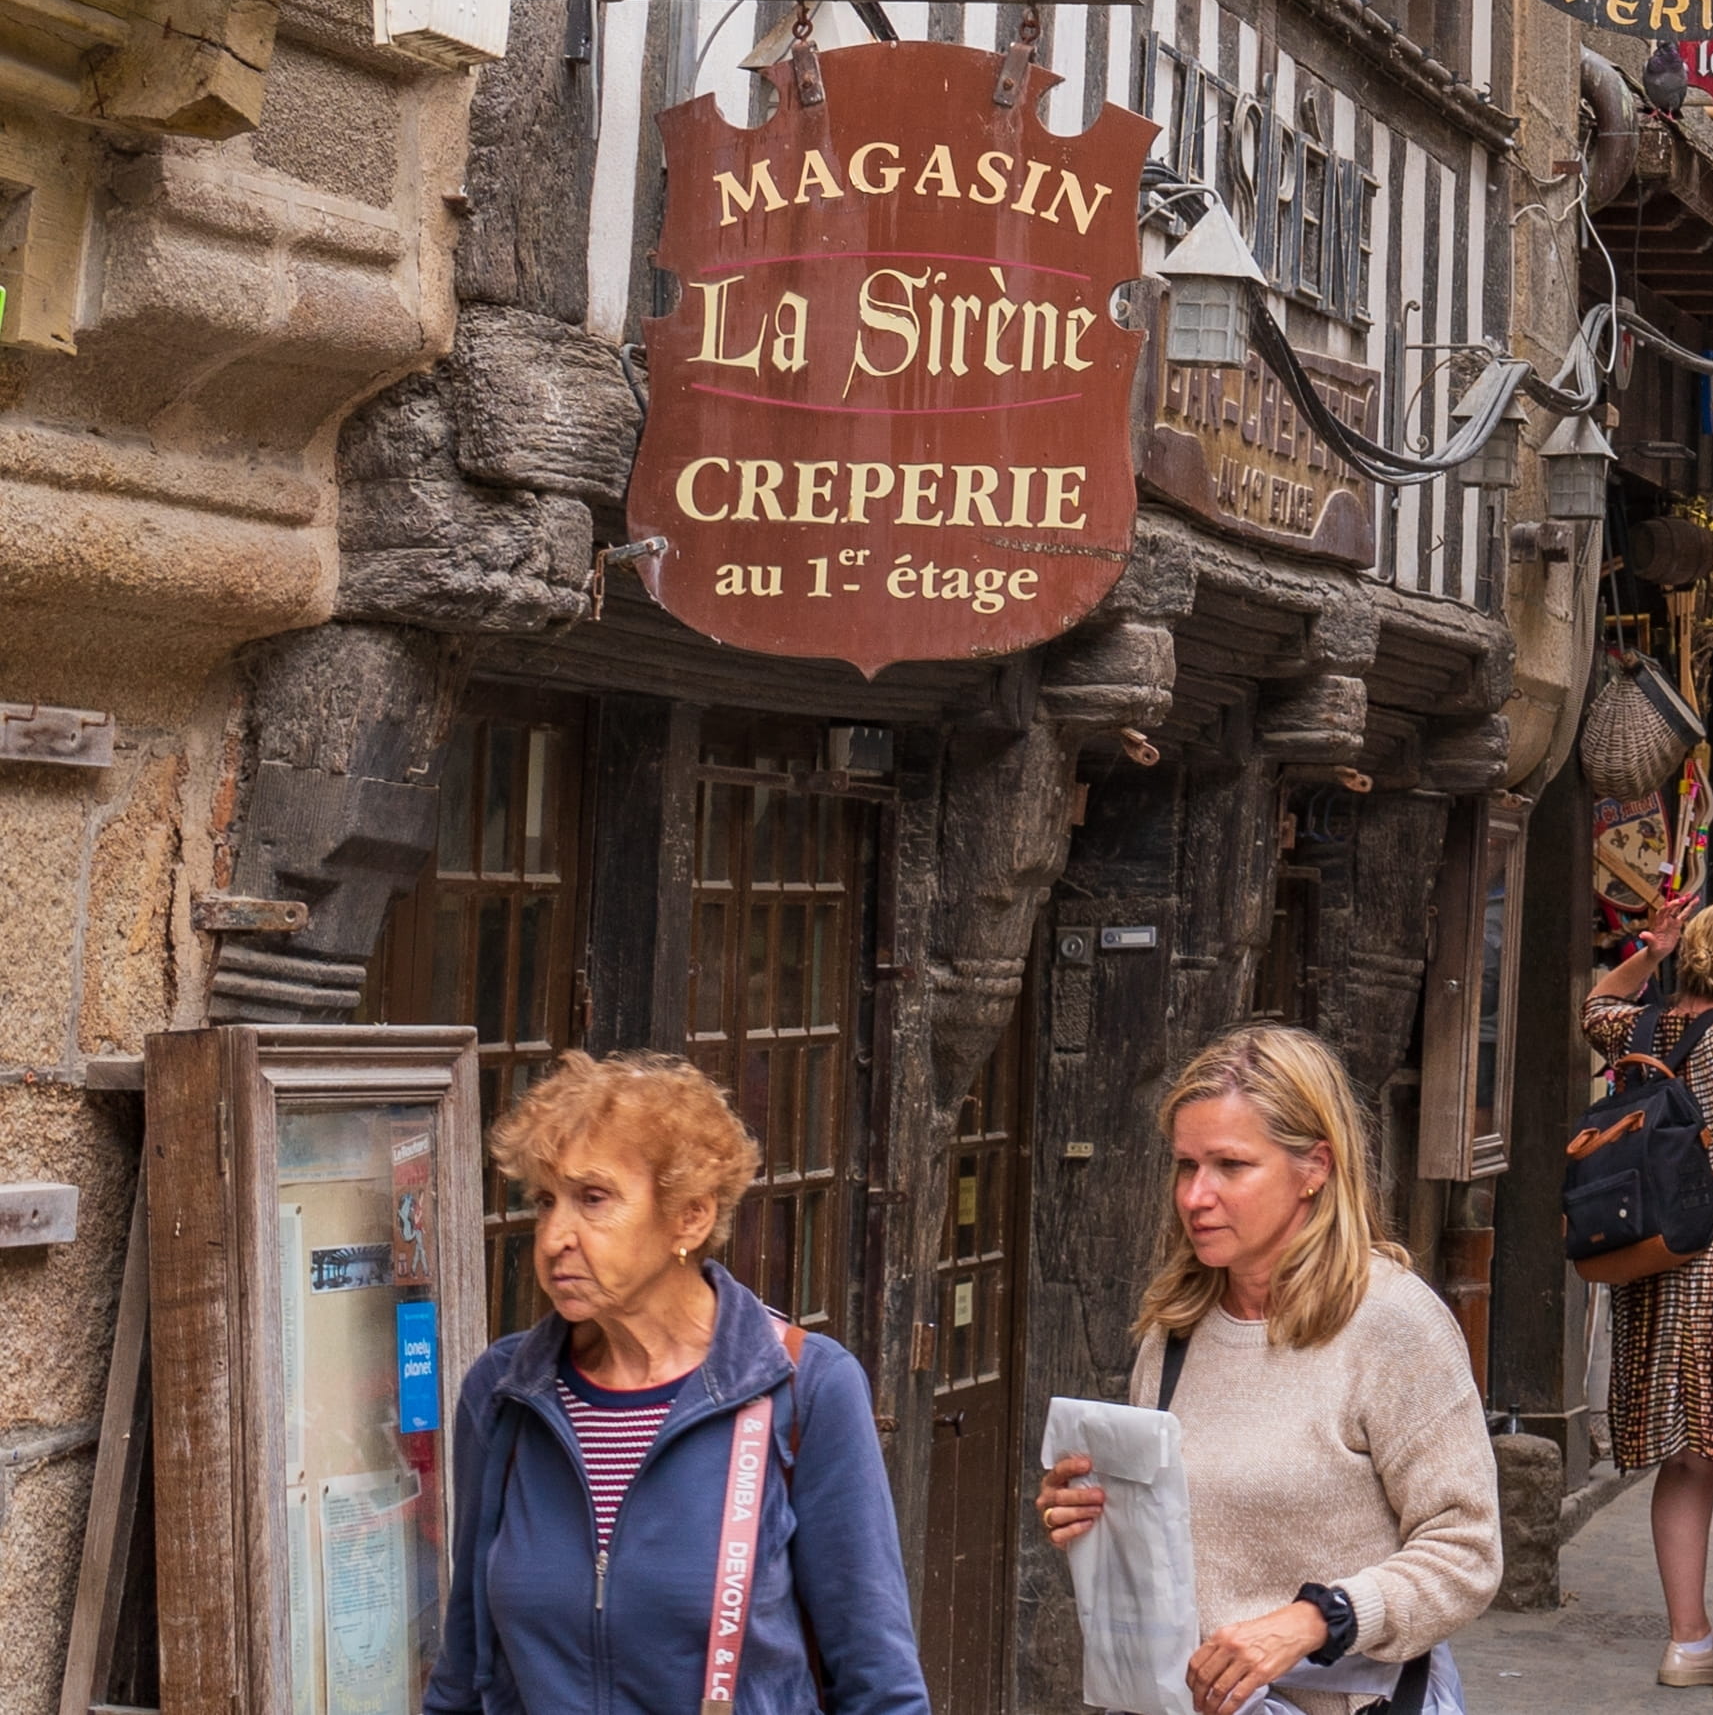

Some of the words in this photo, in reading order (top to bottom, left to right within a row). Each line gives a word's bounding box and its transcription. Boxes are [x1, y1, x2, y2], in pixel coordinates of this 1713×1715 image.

[714, 141, 1112, 235] MAGASIN
[687, 279, 808, 373] La
[842, 266, 1098, 402] Sirène
[675, 457, 1087, 530] CREPERIE
[716, 565, 783, 598] au
[895, 558, 1039, 614] étage
[404, 1337, 431, 1359] lonely
[404, 1359, 432, 1379] planet
[742, 1417, 764, 1434] &
[731, 1440, 760, 1523] LOMBA
[718, 1540, 749, 1637] DEVOTA
[714, 1647, 736, 1666] &
